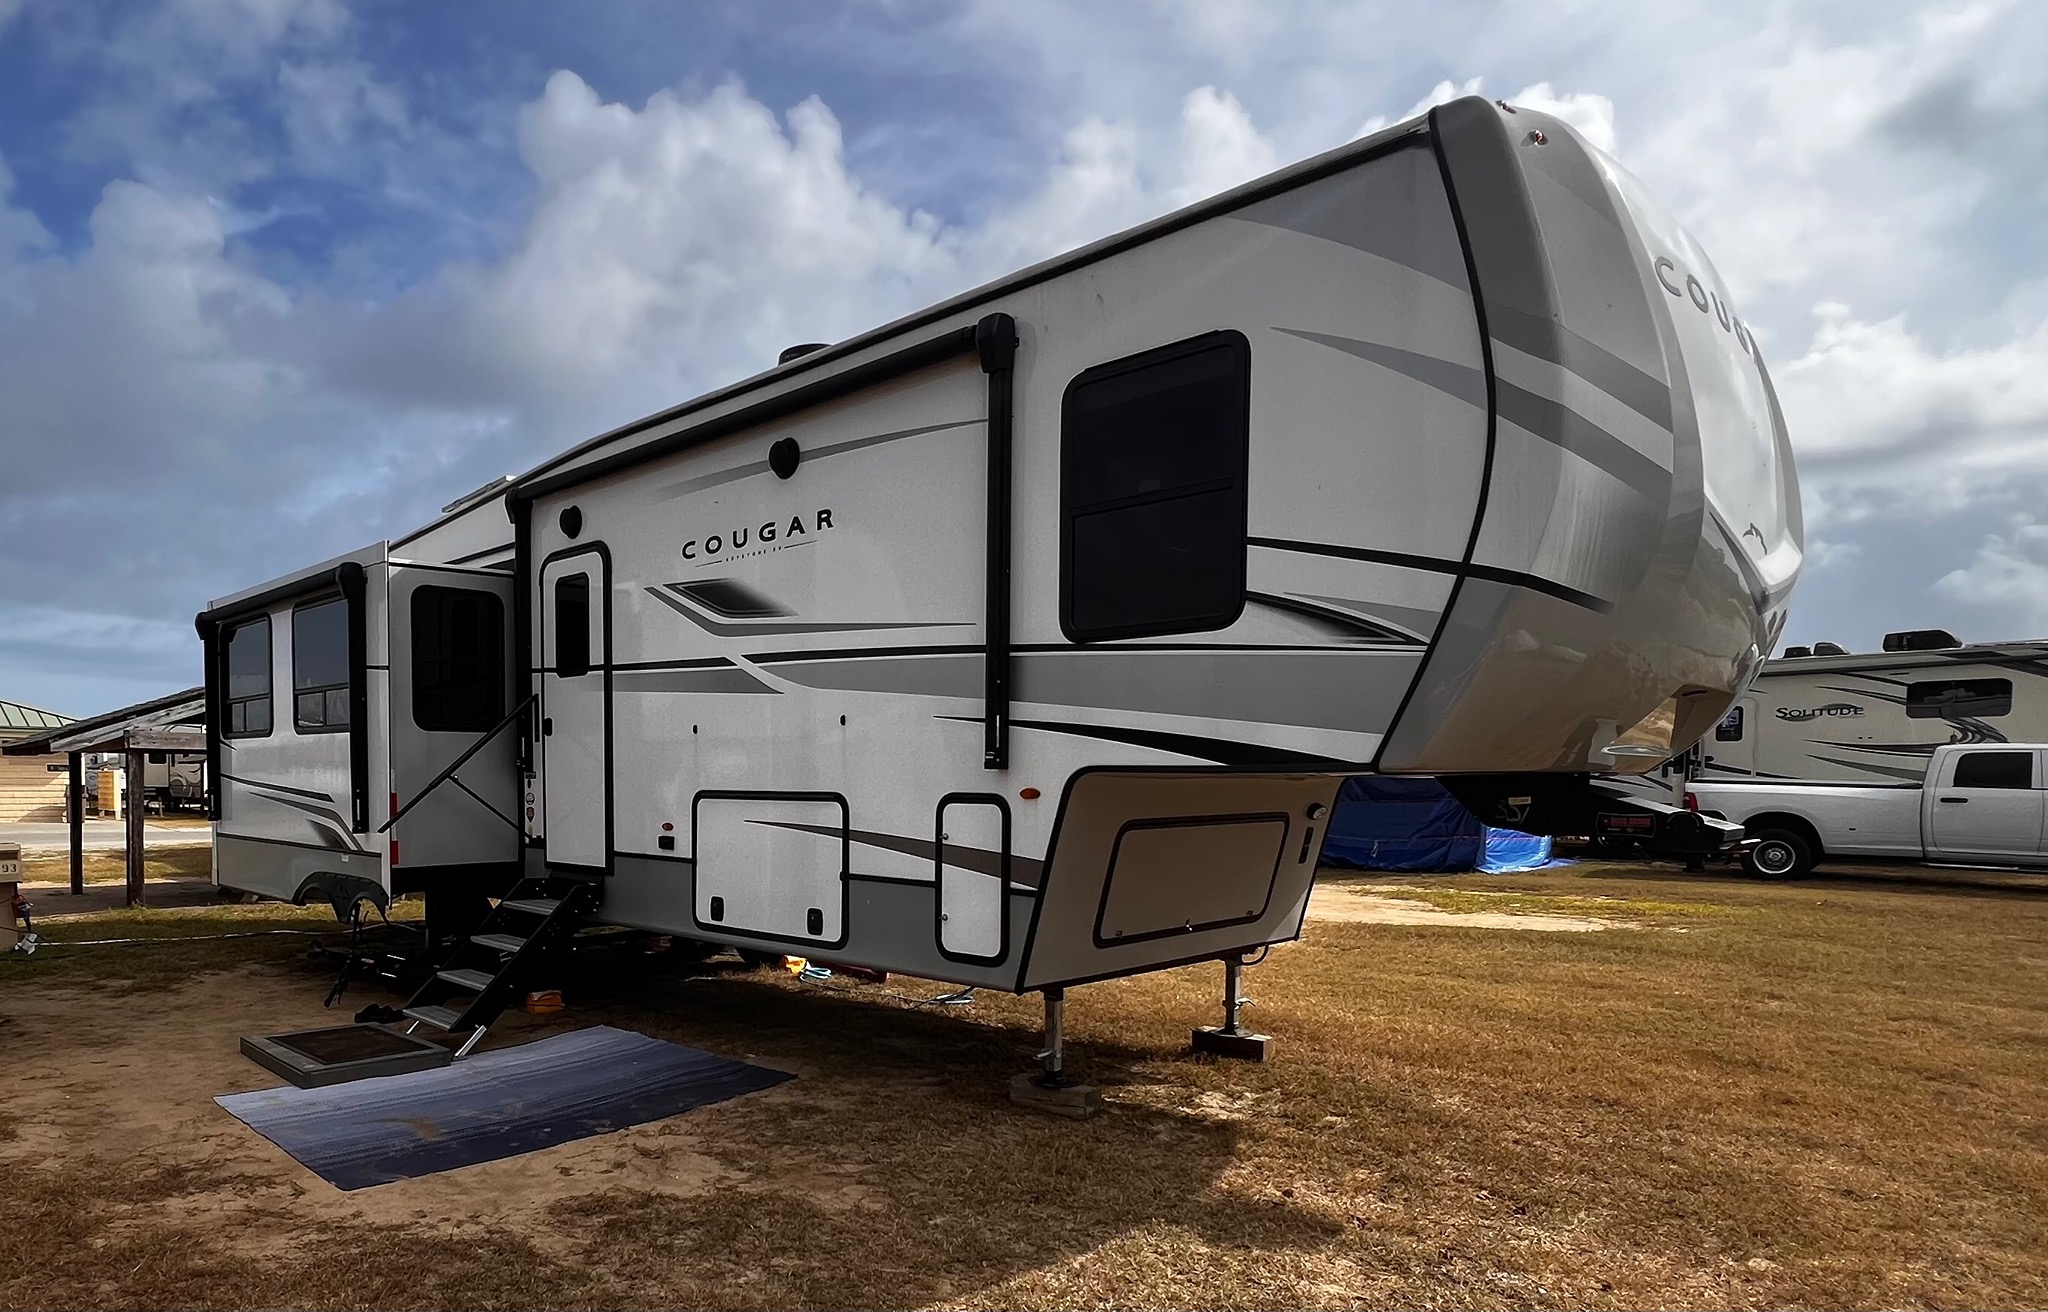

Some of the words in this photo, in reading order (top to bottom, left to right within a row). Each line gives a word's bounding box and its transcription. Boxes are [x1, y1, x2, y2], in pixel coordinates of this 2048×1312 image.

[1654, 256, 1754, 356] COUG
[681, 509, 834, 560] COUGAR
[1775, 706, 1864, 719] SOLITUDE
[2, 863, 17, 873] 93
